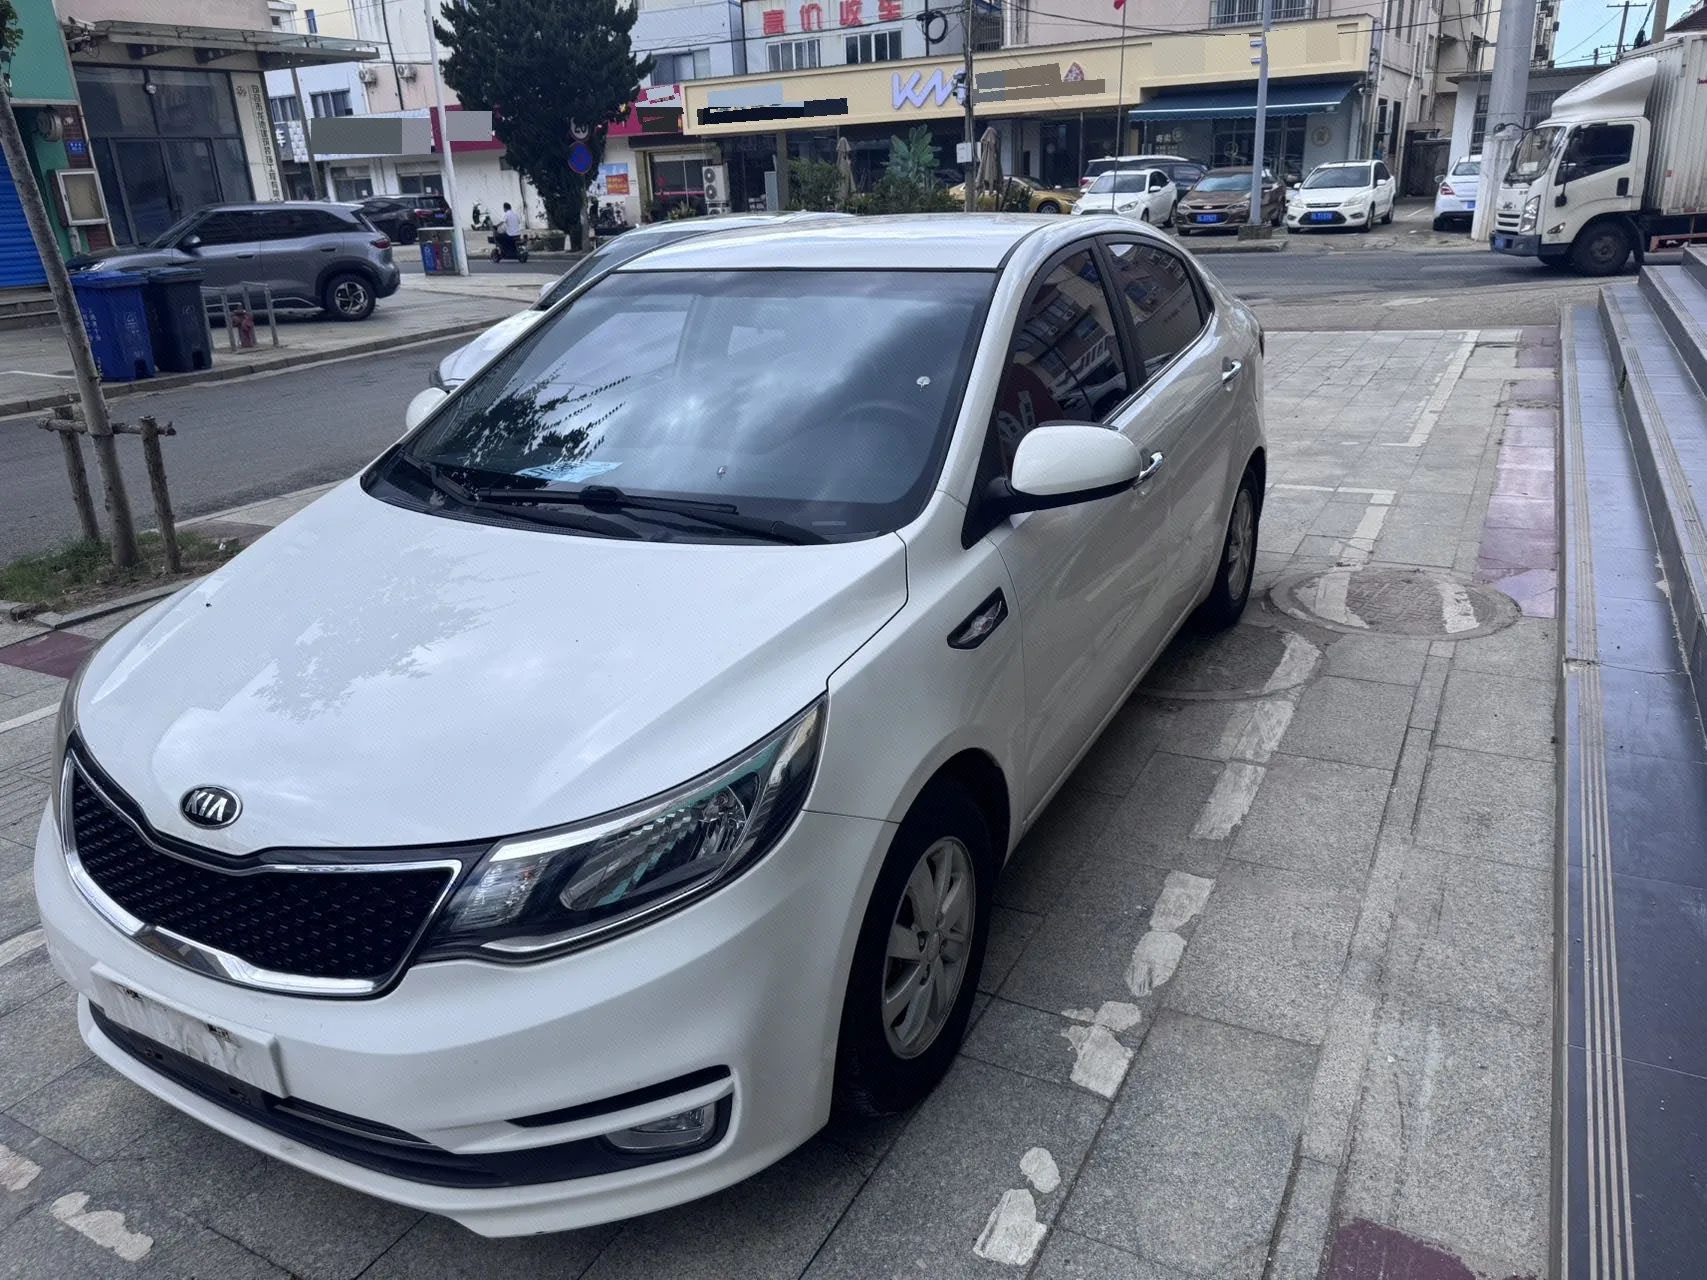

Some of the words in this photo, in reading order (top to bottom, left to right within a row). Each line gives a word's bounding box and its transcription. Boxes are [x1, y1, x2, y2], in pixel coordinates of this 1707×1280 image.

[761, 0, 903, 35] 高价收车
[185, 790, 228, 821] KIA
